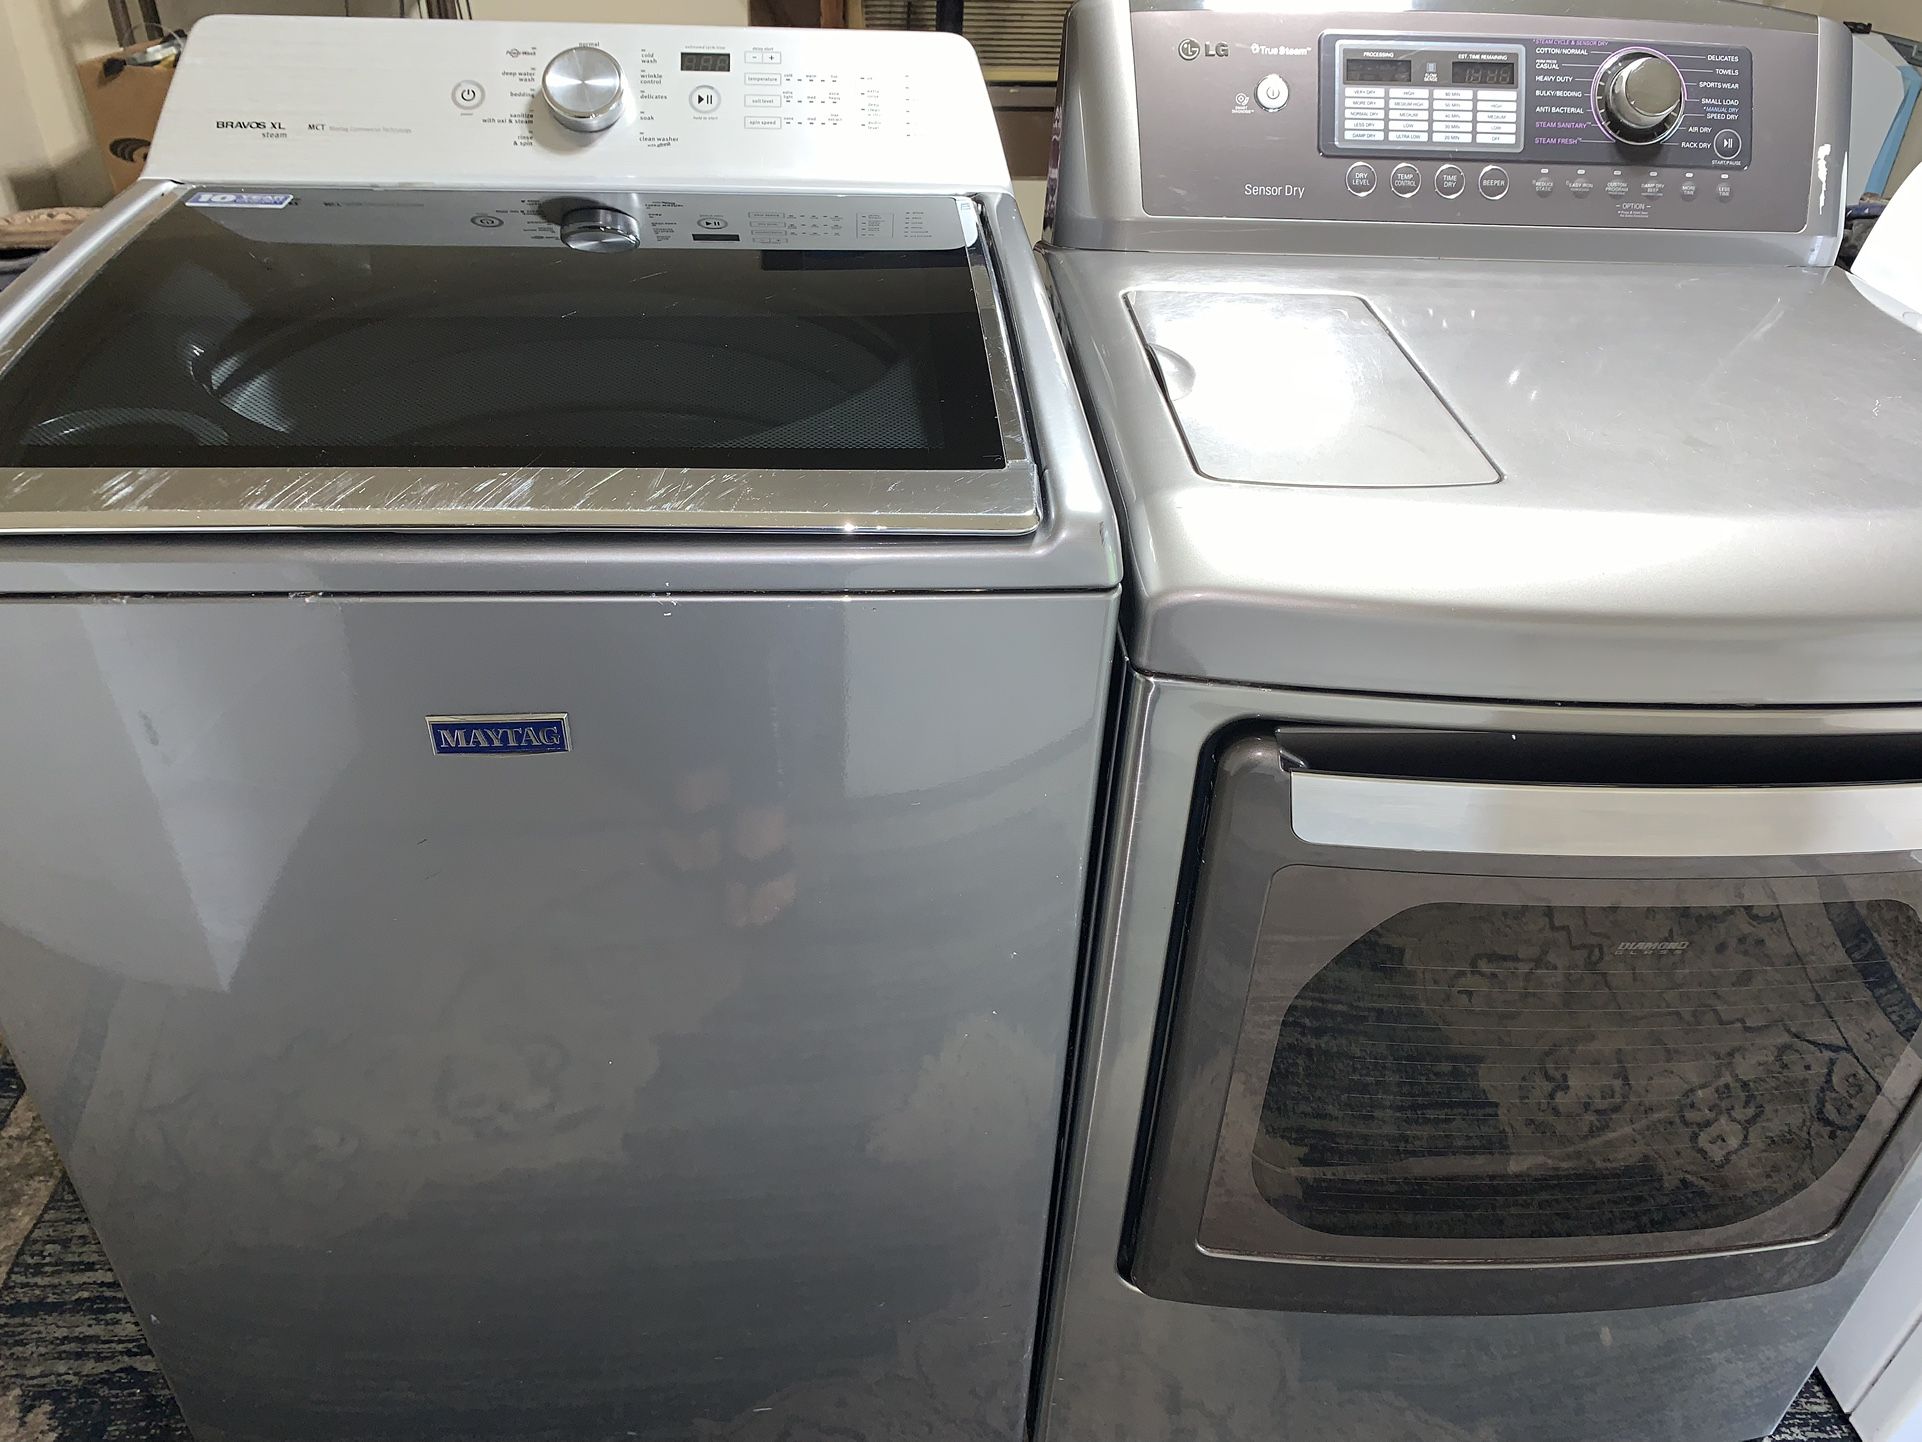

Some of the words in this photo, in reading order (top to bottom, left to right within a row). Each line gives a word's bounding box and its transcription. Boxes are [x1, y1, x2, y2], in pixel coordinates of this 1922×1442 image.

[1204, 41, 1229, 57] LG
[1535, 47, 1589, 55] COTTON/NORMAL
[1707, 54, 1739, 62] DELICATES
[216, 121, 266, 130] BRAVOS
[270, 122, 286, 130] XL
[1244, 184, 1283, 196] Sensor
[1285, 184, 1305, 198] Dry
[198, 194, 237, 202] 10
[1622, 202, 1645, 210] OPTION
[437, 726, 560, 748] MAYTAG
[1618, 941, 1690, 950] DIAMOND
